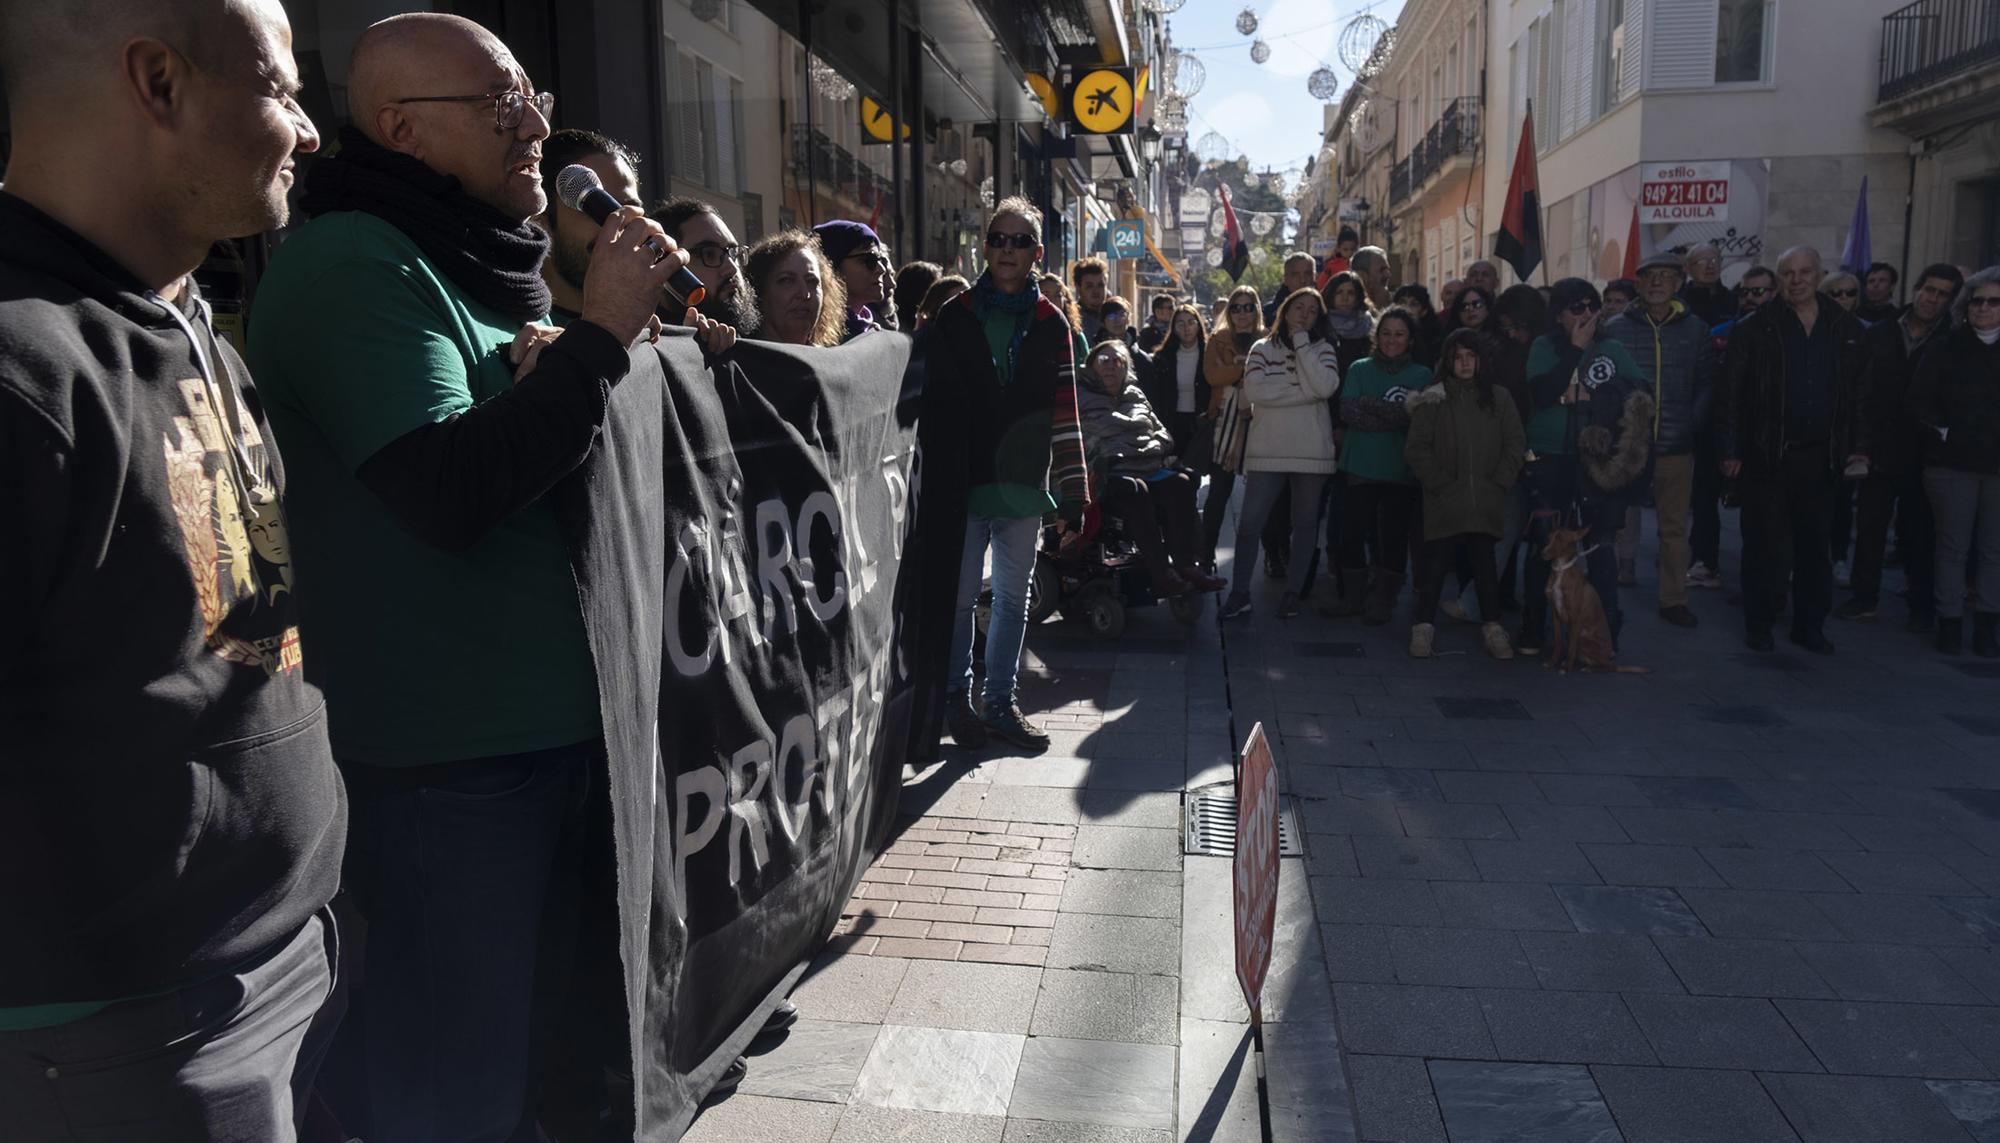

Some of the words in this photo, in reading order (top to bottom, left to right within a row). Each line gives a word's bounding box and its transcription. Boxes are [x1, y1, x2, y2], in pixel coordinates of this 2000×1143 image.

[1658, 166, 1696, 179] estilo
[1645, 185, 1668, 204] 949
[1669, 184, 1684, 204] 21
[1688, 184, 1702, 203] 41
[1706, 182, 1726, 202] 04
[1653, 205, 1715, 219] ALQUILA
